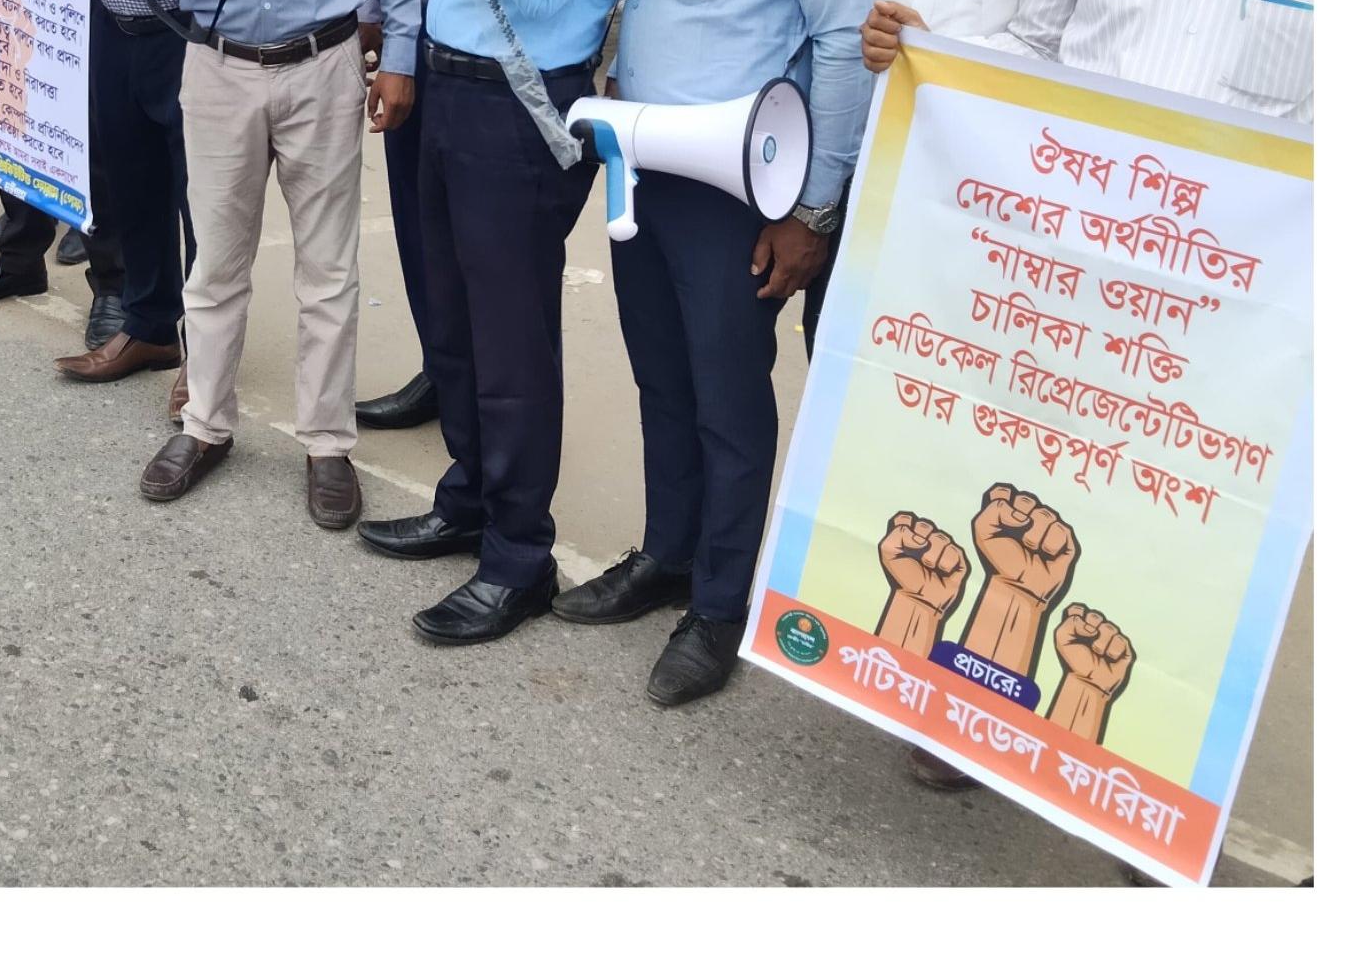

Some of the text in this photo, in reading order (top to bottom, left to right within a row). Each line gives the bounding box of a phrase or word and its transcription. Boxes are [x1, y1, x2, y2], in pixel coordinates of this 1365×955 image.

[1029, 126, 1210, 220] ঔষধ শিল্প
[955, 176, 1261, 293] দেশের অর্থনীতির
[970, 226, 1221, 336] “নাম্বার ওয়ান”
[969, 288, 1190, 384] চালিকা শক্তি
[872, 312, 1273, 484] মেডিকেল রিপ্রেজেন্টেটিভগণ
[893, 371, 1220, 524] তার গুরুত্বপূর্ণ অংশ
[954, 651, 1023, 699] প্রচারে:
[838, 643, 1186, 847] পটিয়া মডেল ফারিয়া
